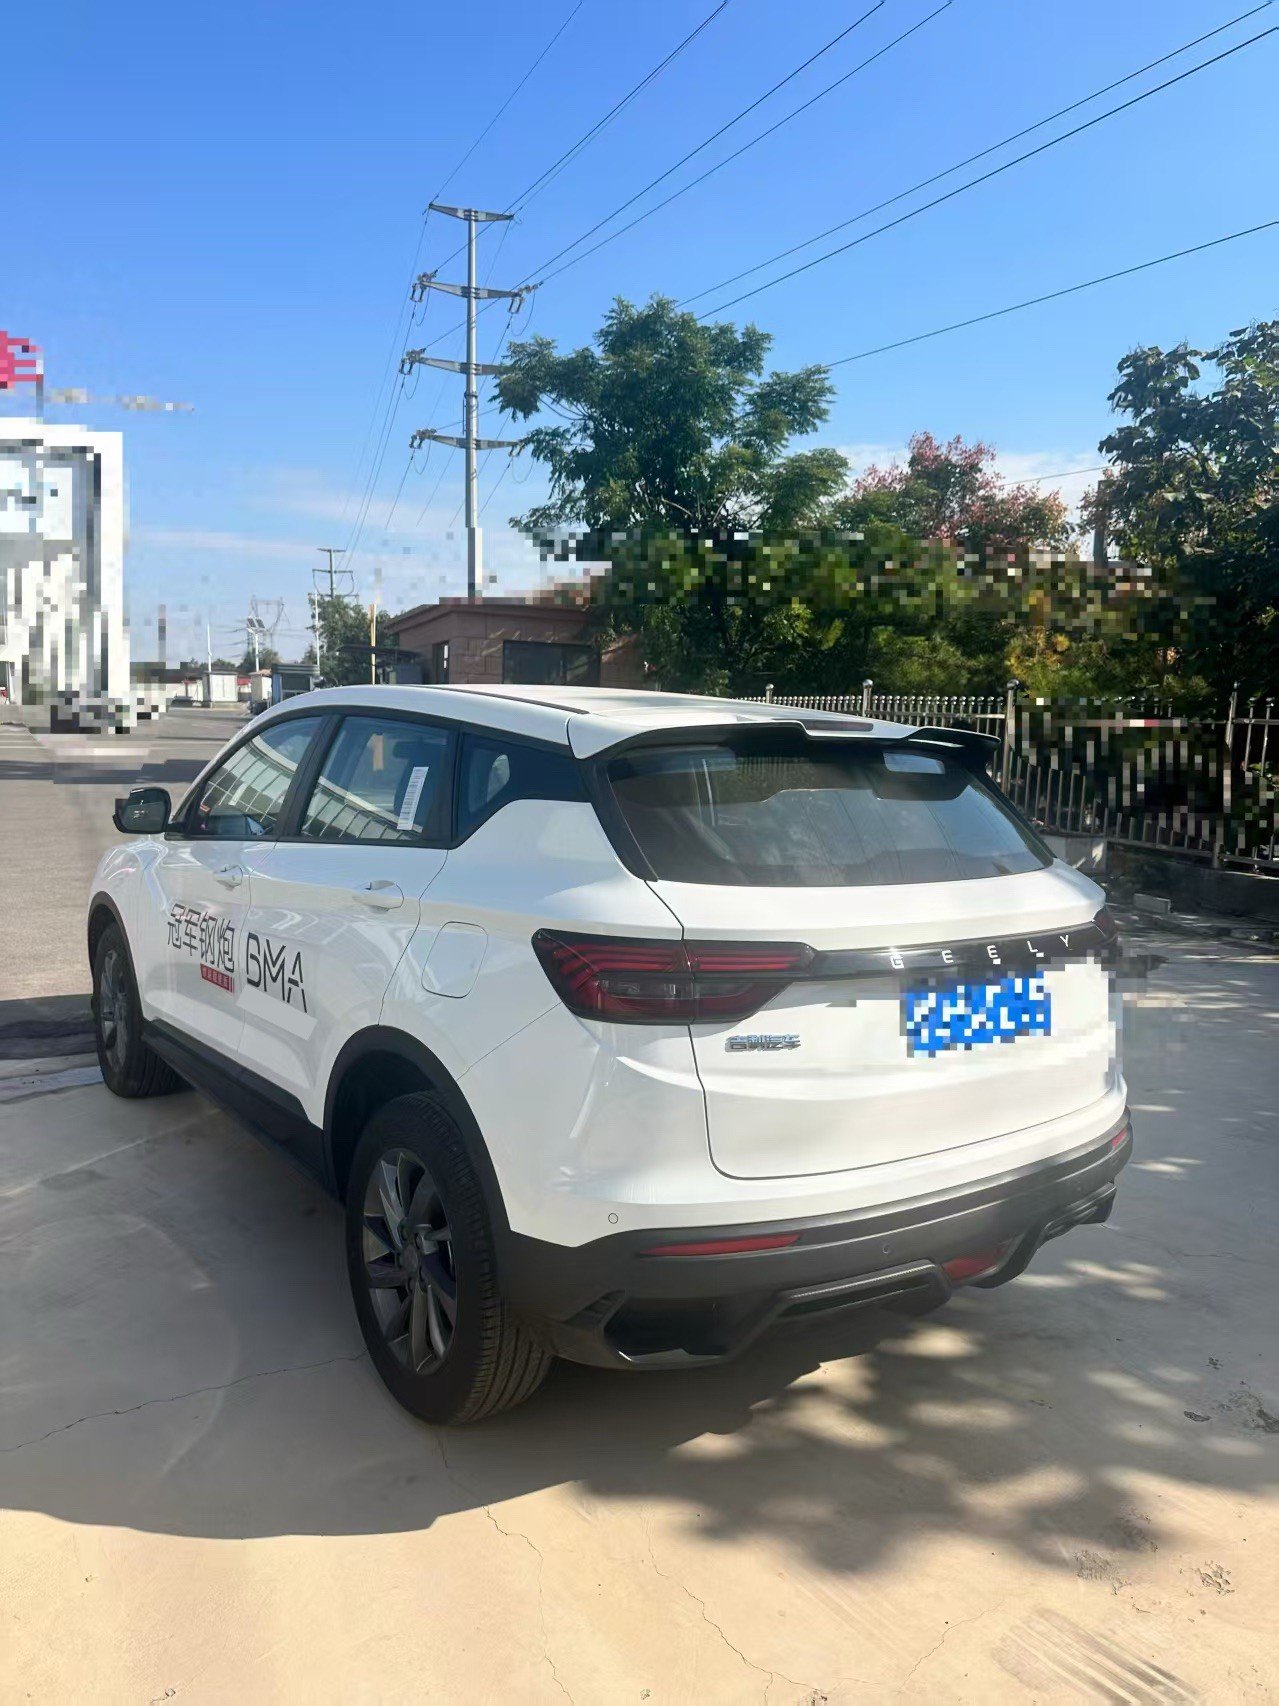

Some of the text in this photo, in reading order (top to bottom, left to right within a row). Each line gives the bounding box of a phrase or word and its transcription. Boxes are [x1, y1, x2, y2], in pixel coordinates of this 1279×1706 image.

[167, 903, 235, 973] 冠军钢炮
[247, 932, 307, 1013] BMA
[890, 934, 1072, 969] GEELY
